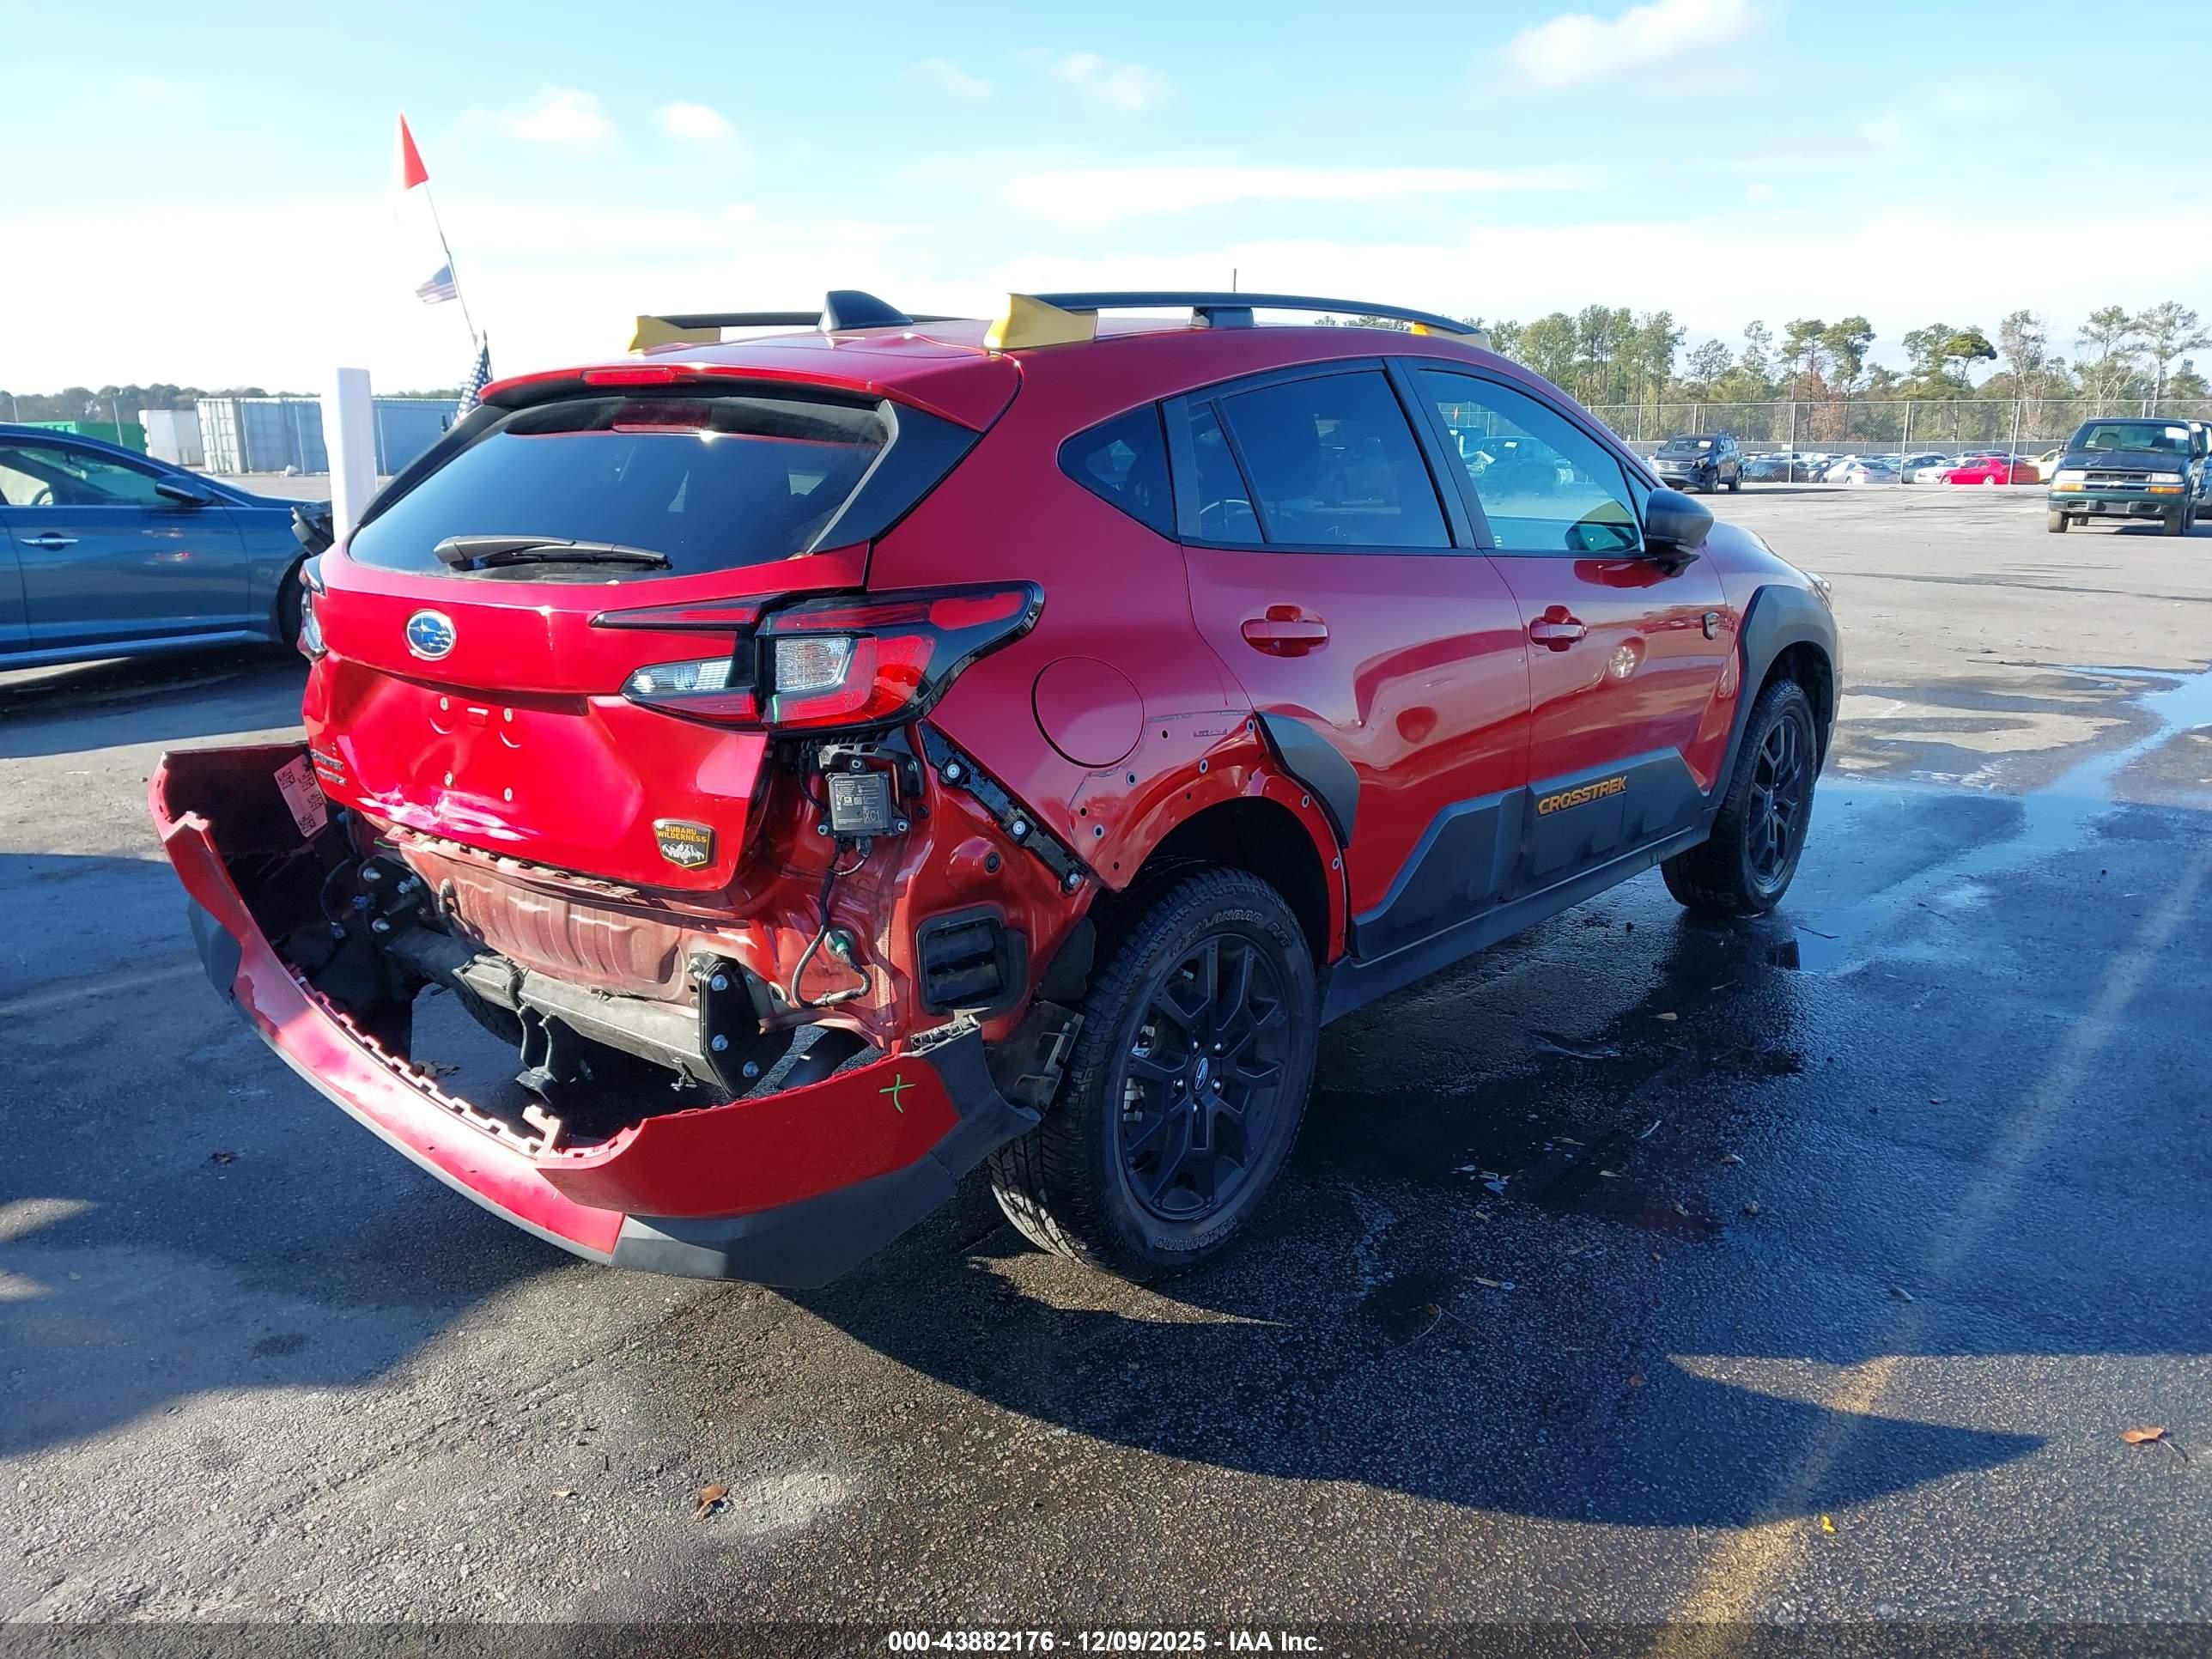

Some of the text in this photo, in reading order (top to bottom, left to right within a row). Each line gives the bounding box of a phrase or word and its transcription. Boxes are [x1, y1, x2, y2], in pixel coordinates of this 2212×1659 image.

[1538, 775, 1628, 816] CROSSTREK
[657, 830, 708, 843] WILDERNESS
[665, 825, 697, 836] SUBARU
